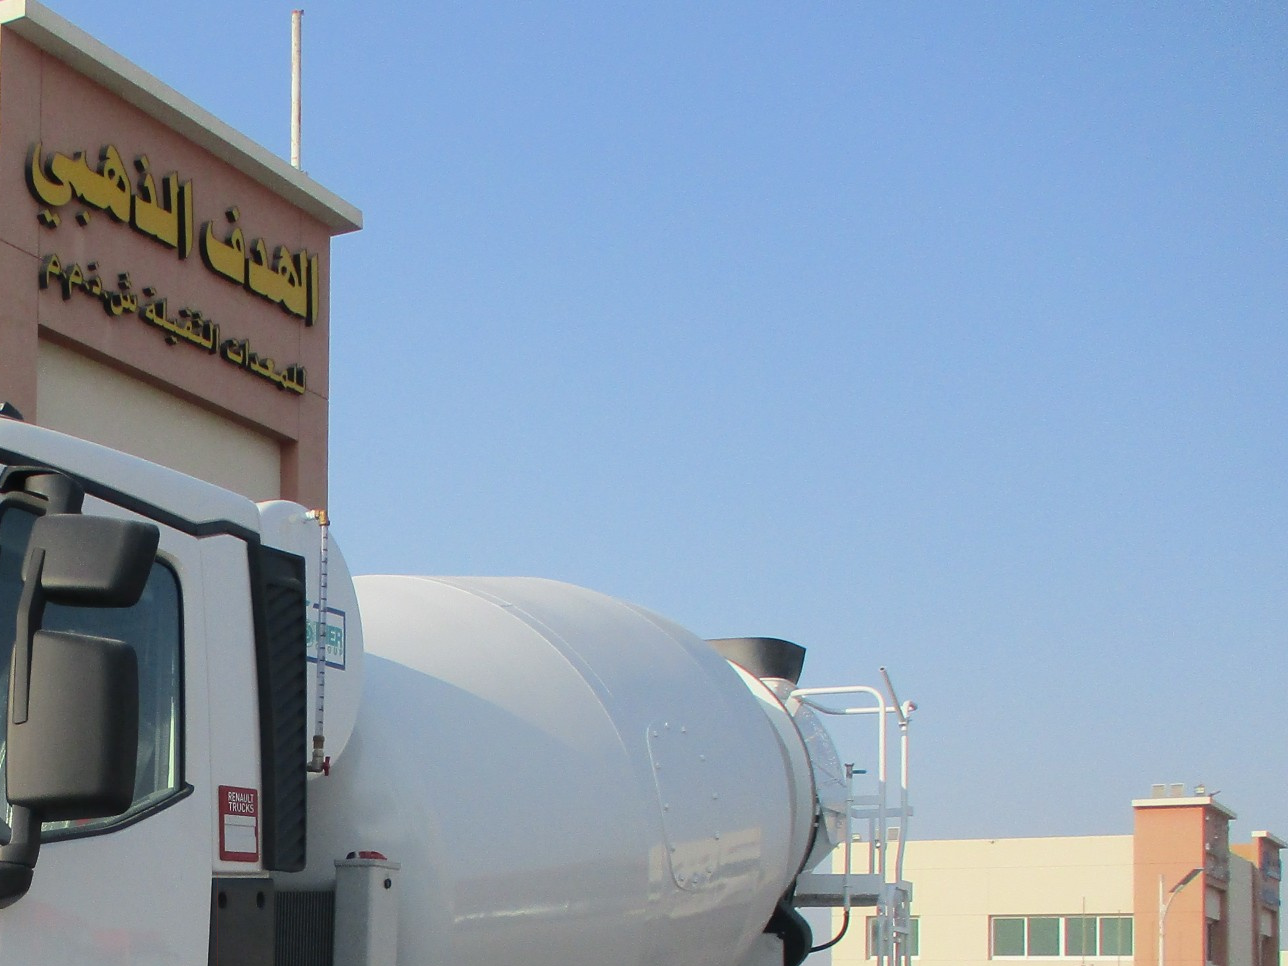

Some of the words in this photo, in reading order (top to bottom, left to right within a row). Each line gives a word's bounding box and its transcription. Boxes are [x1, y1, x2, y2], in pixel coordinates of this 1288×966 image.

[25, 140, 194, 260] الذهبي
[199, 206, 319, 327] الهدف
[139, 287, 220, 355] الثقيلة
[220, 338, 307, 395] للمعدات
[227, 791, 254, 803] RENAULT
[228, 801, 255, 814] TRUCKS
